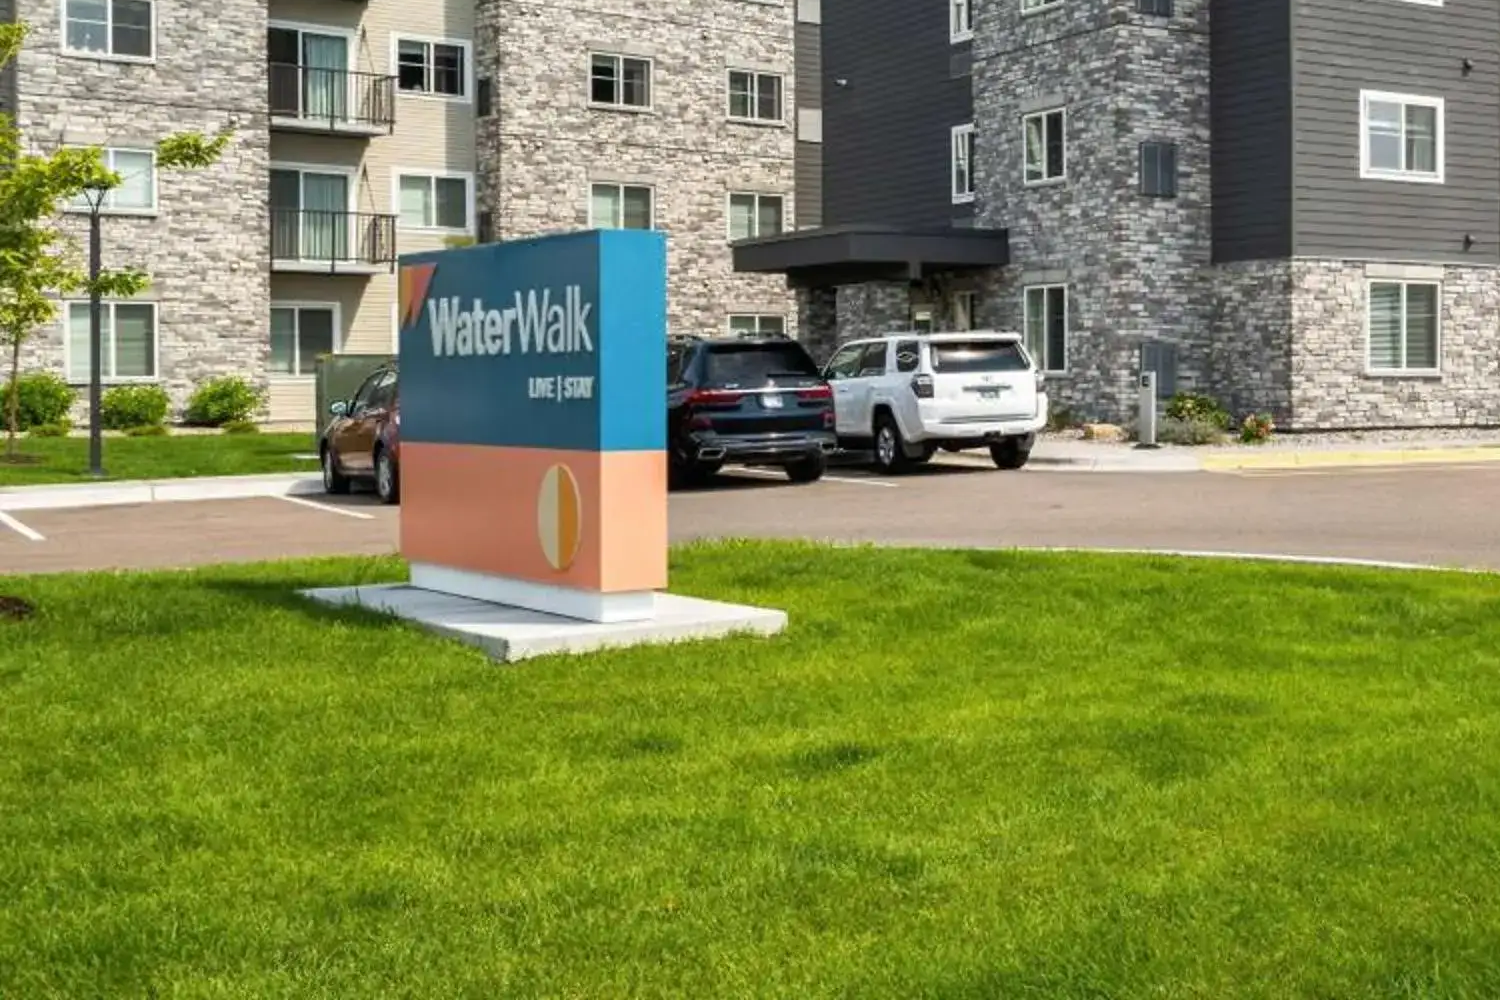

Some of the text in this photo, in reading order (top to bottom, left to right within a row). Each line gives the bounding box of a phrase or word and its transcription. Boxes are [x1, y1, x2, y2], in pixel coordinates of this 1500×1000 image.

[428, 285, 593, 357] WaterWalk
[528, 376, 594, 399] LIVE STAY
